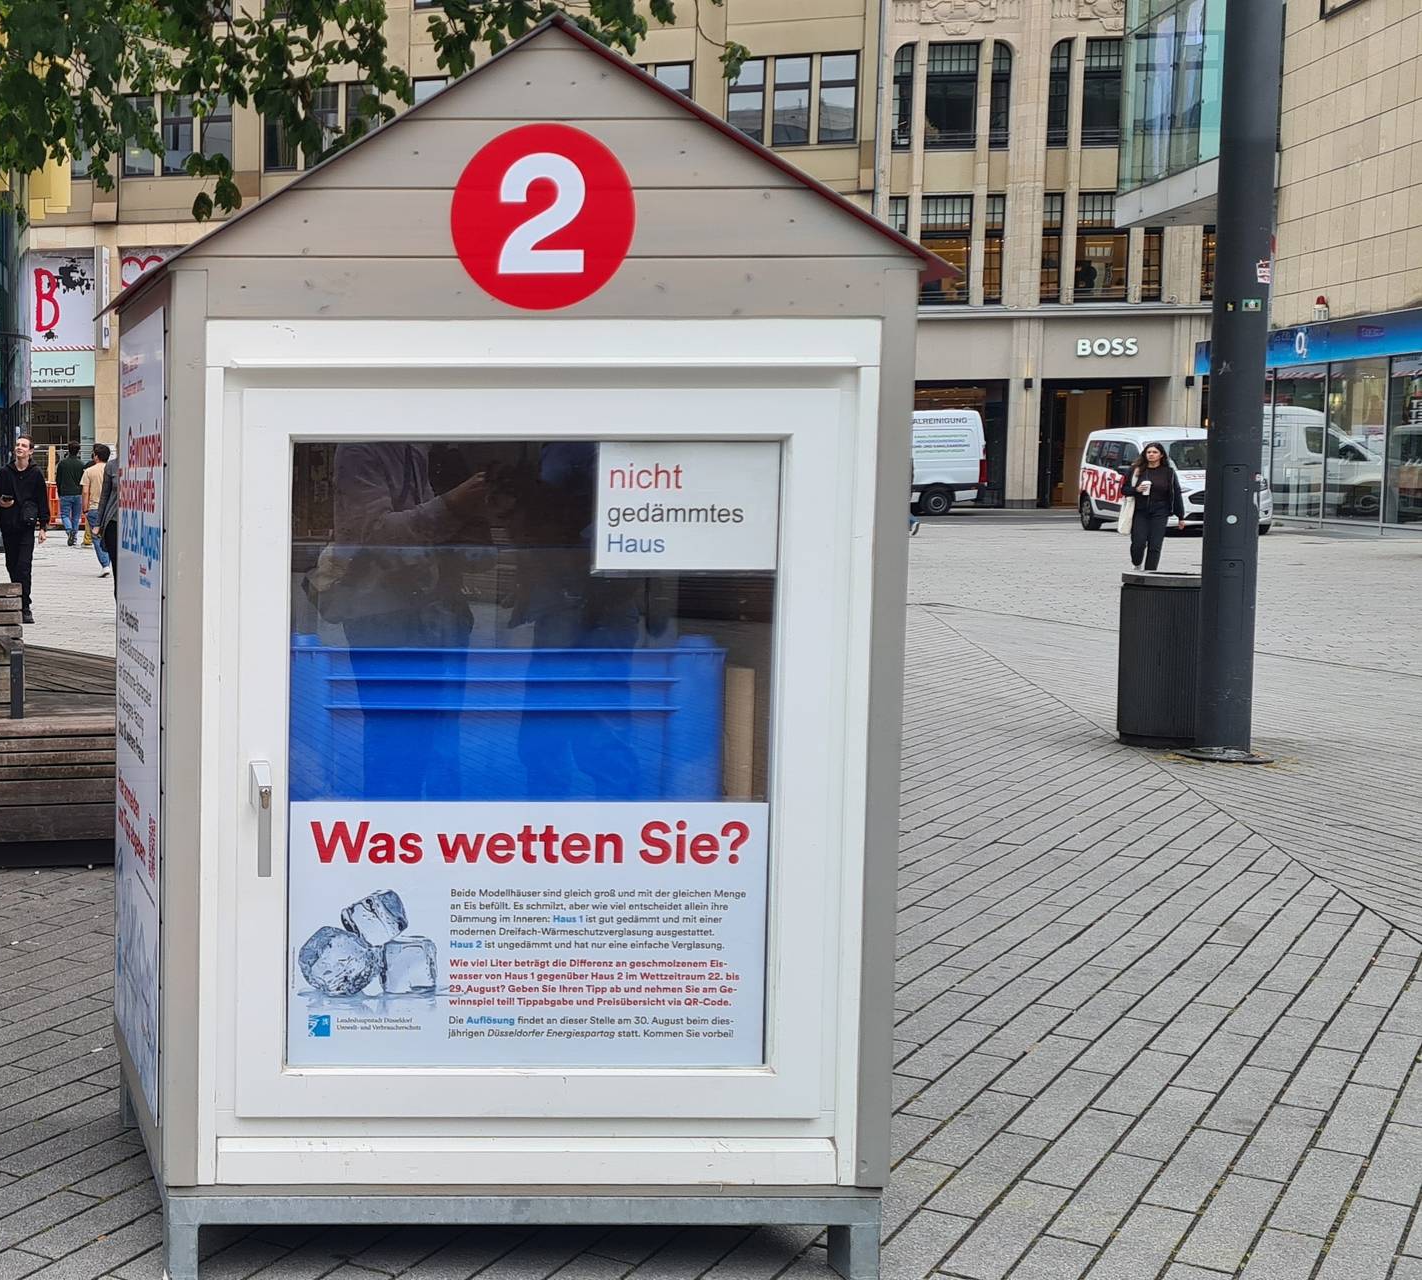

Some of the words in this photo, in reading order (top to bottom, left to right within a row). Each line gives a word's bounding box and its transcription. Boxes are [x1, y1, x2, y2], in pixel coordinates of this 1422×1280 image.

[498, 152, 586, 274] 2
[34, 268, 60, 332] B
[1077, 338, 1138, 356] BOSS
[128, 418, 162, 469] Gewinnspiel
[610, 463, 683, 489] nicht
[608, 503, 744, 528] gedämmtes
[608, 534, 666, 553] Haus
[310, 821, 424, 864] Was
[438, 825, 622, 864] wetten
[639, 821, 750, 864] Sie?
[450, 889, 476, 898] Beide
[478, 889, 541, 898] Modellhäuser
[542, 889, 562, 898] sind
[563, 889, 592, 900] gleich
[594, 889, 616, 900] groß
[618, 889, 636, 898] und
[637, 889, 652, 898] mit
[654, 889, 670, 898] der
[672, 889, 712, 900] gleichen
[713, 889, 746, 900] Menge
[464, 902, 476, 911] Eis
[478, 902, 510, 911] befüllt.
[513, 902, 524, 911] Es
[525, 902, 566, 912] schmilzt,
[568, 902, 590, 911] aber
[591, 902, 608, 911] wie
[610, 902, 626, 911] viel
[628, 902, 682, 911] entscheidet
[684, 902, 708, 911] allein
[710, 902, 729, 911] ihre
[450, 915, 497, 926] Dämmung
[499, 915, 510, 924] im
[513, 915, 550, 924] Inneren:
[552, 915, 576, 924] Haus
[585, 915, 596, 924] ist
[598, 915, 614, 926] gut
[616, 915, 660, 926] gedämmt
[662, 915, 680, 924] und
[682, 915, 696, 924] mit
[698, 915, 722, 924] einer
[450, 928, 496, 937] modernen
[498, 928, 654, 939] Dreifach-Wärmeschutzverglasung
[655, 928, 715, 939] ausgestattet.
[449, 940, 474, 949] Haus
[484, 940, 495, 949] ist
[497, 940, 552, 952] ungedämmt
[554, 940, 572, 949] und
[574, 940, 588, 950] hat
[608, 941, 628, 950] eine
[630, 941, 669, 950] einfache
[671, 941, 724, 952] Verglasung.
[449, 998, 494, 1009] winnspiel
[496, 998, 514, 1006] teil!
[517, 998, 574, 1009] Tippabgabe
[576, 998, 594, 1006] und
[596, 998, 666, 1006] Preisübersicht
[667, 998, 682, 1006] via
[684, 998, 732, 1006] QR-Code.
[448, 1016, 464, 1025] Die
[466, 1016, 515, 1027] Auflösung
[517, 1016, 544, 1025] findet
[559, 1016, 588, 1025] dieser
[590, 1016, 615, 1025] Stelle
[634, 1016, 649, 1025] 30.
[651, 1016, 684, 1028] August
[686, 1016, 709, 1025] beim
[710, 1016, 734, 1026] dies-
[448, 1029, 485, 1040] jährigen
[487, 1029, 544, 1038] Düsseldorfer
[546, 1029, 615, 1040] Energiespartag
[617, 1030, 640, 1038] statt.
[643, 1029, 684, 1038] Kommen
[685, 1029, 700, 1038] Sie
[702, 1029, 734, 1038] vorbei!
